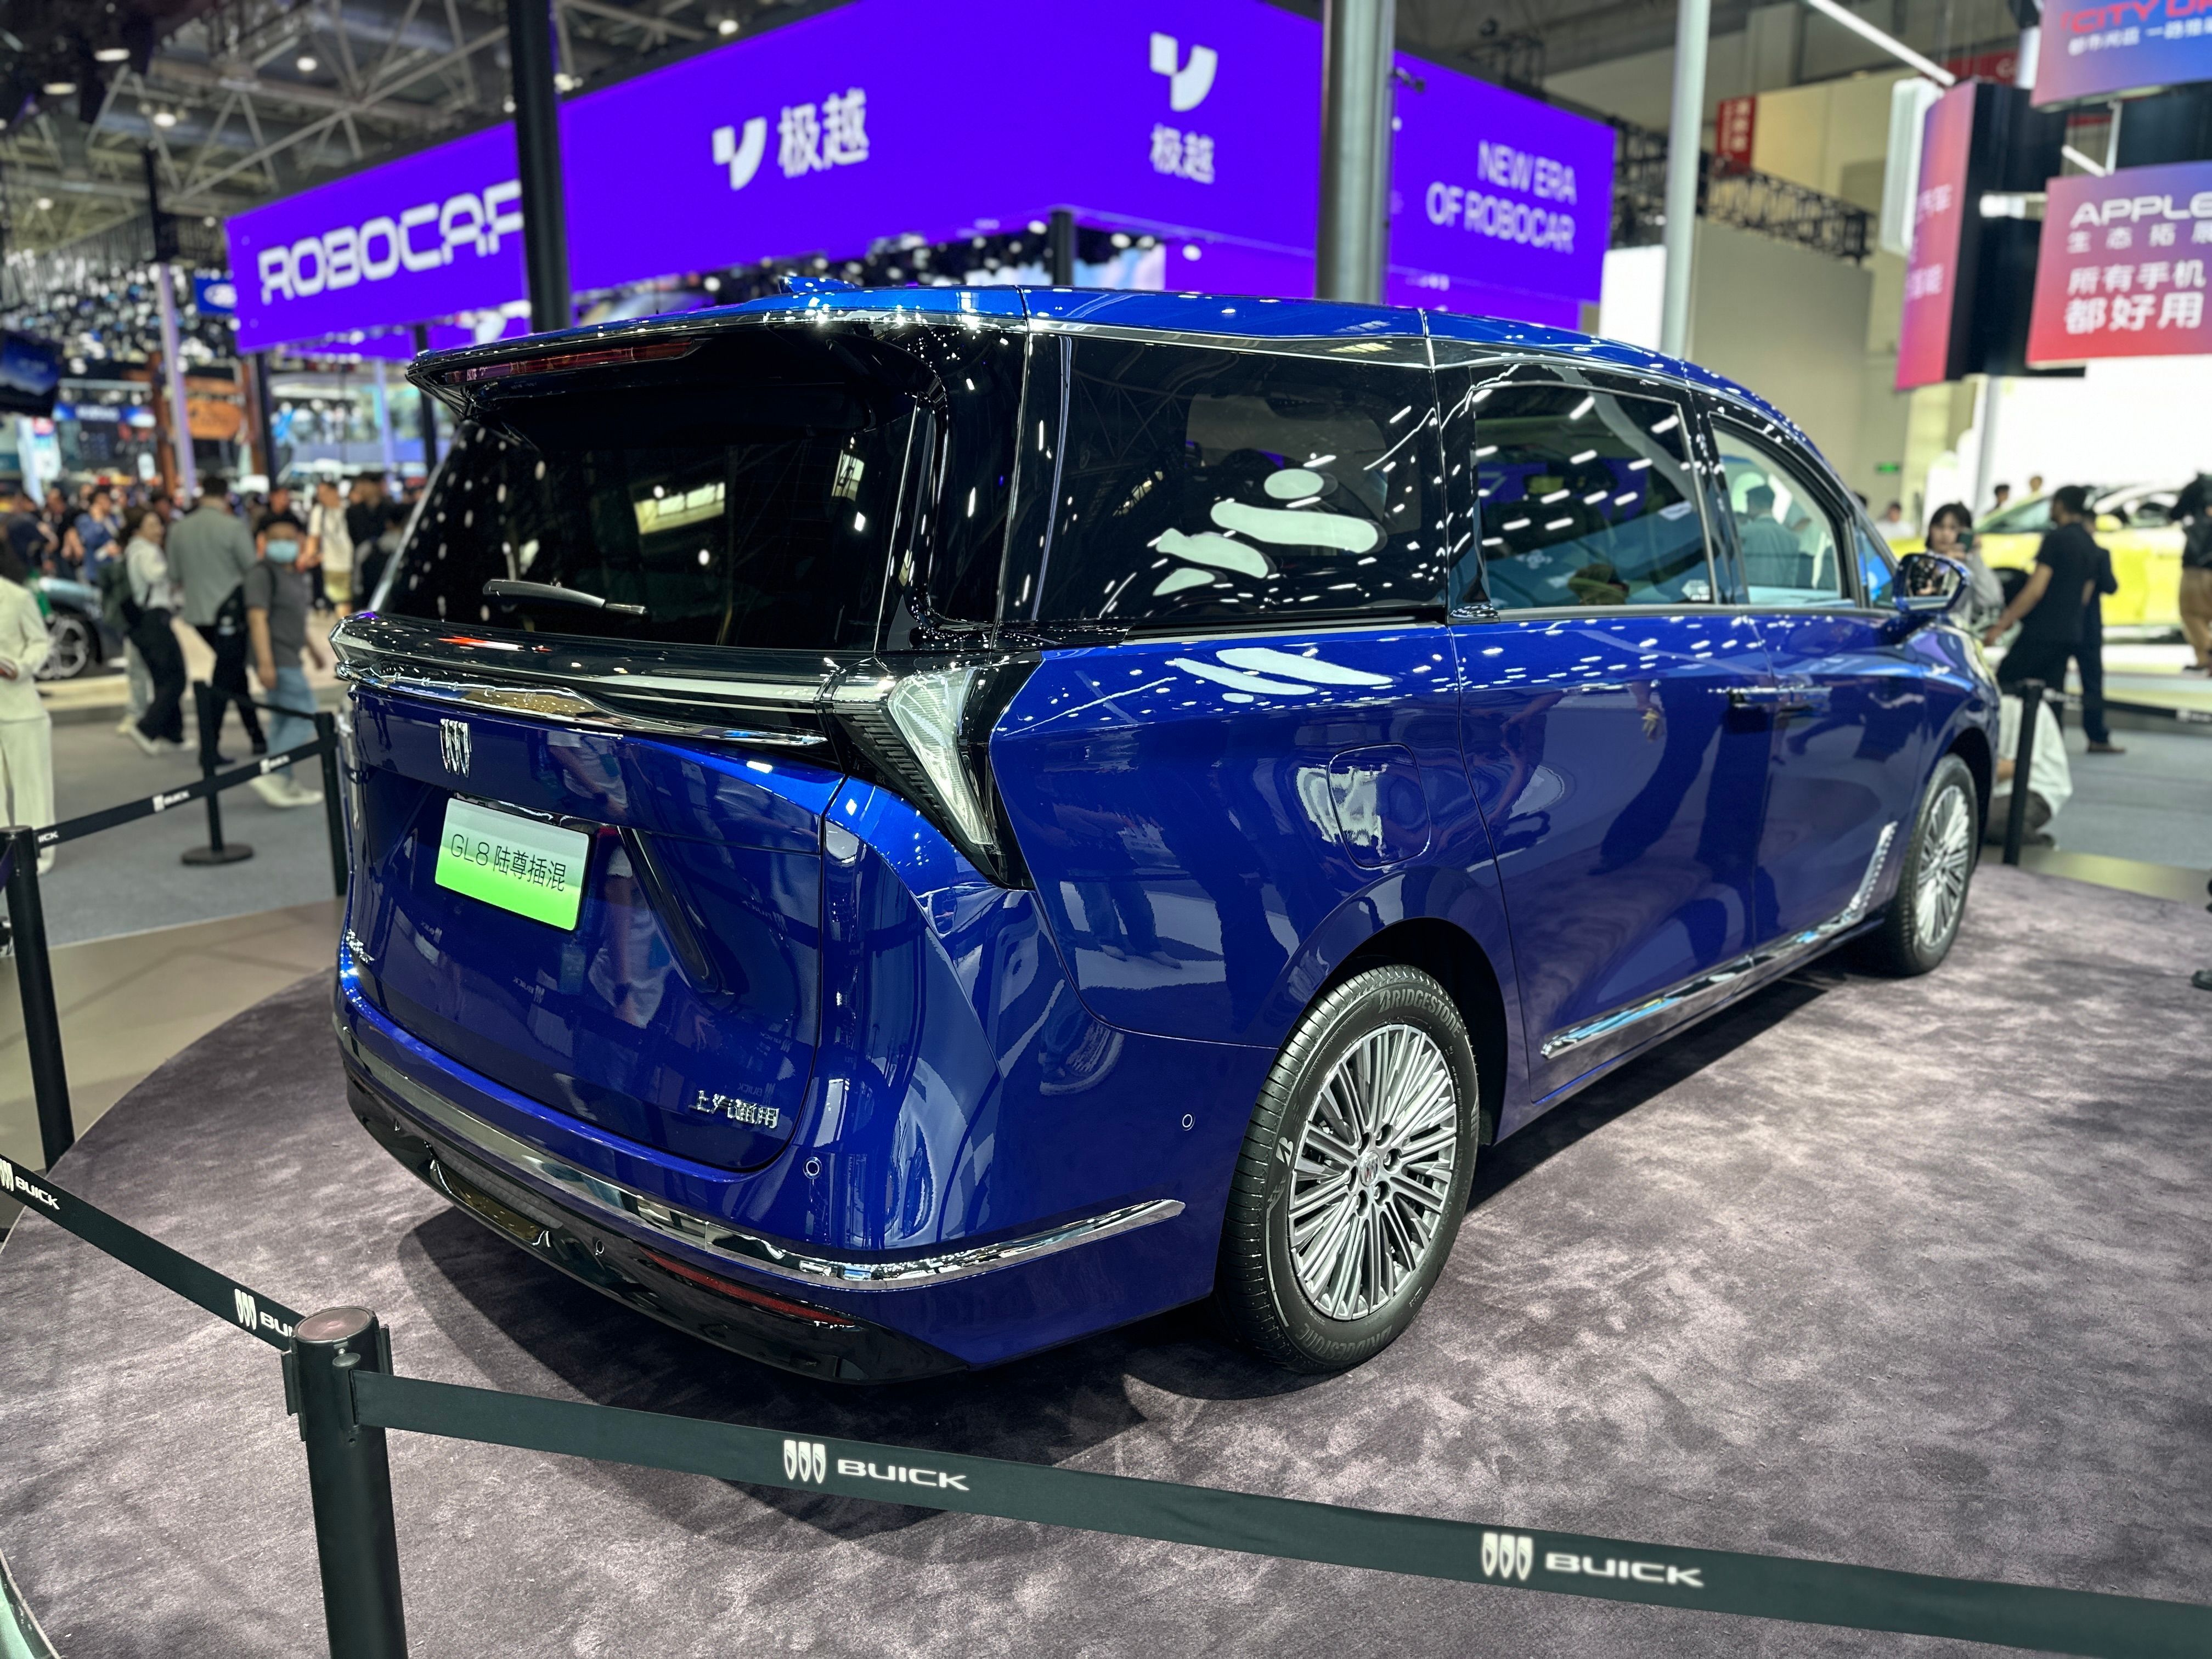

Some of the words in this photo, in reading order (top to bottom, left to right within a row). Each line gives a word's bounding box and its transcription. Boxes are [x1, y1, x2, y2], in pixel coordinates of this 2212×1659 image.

[777, 88, 869, 177] 极越
[1150, 123, 1215, 184] 极越
[1477, 139, 1534, 192] NEW
[1534, 156, 1577, 206] ERA
[1426, 181, 1465, 228] OF
[1464, 189, 1576, 255] ROBOCAR
[2067, 259, 2207, 296] 所有手机
[2064, 292, 2204, 335] 都好用
[450, 834, 490, 866] GL8
[493, 845, 567, 892] 陆尊插混
[1378, 988, 1462, 1038] BRIDGESTONE
[15, 1176, 60, 1210] BUICK
[260, 1311, 294, 1337] BUI
[837, 1459, 970, 1491] BUICK
[1545, 1552, 1705, 1588] BUICK
